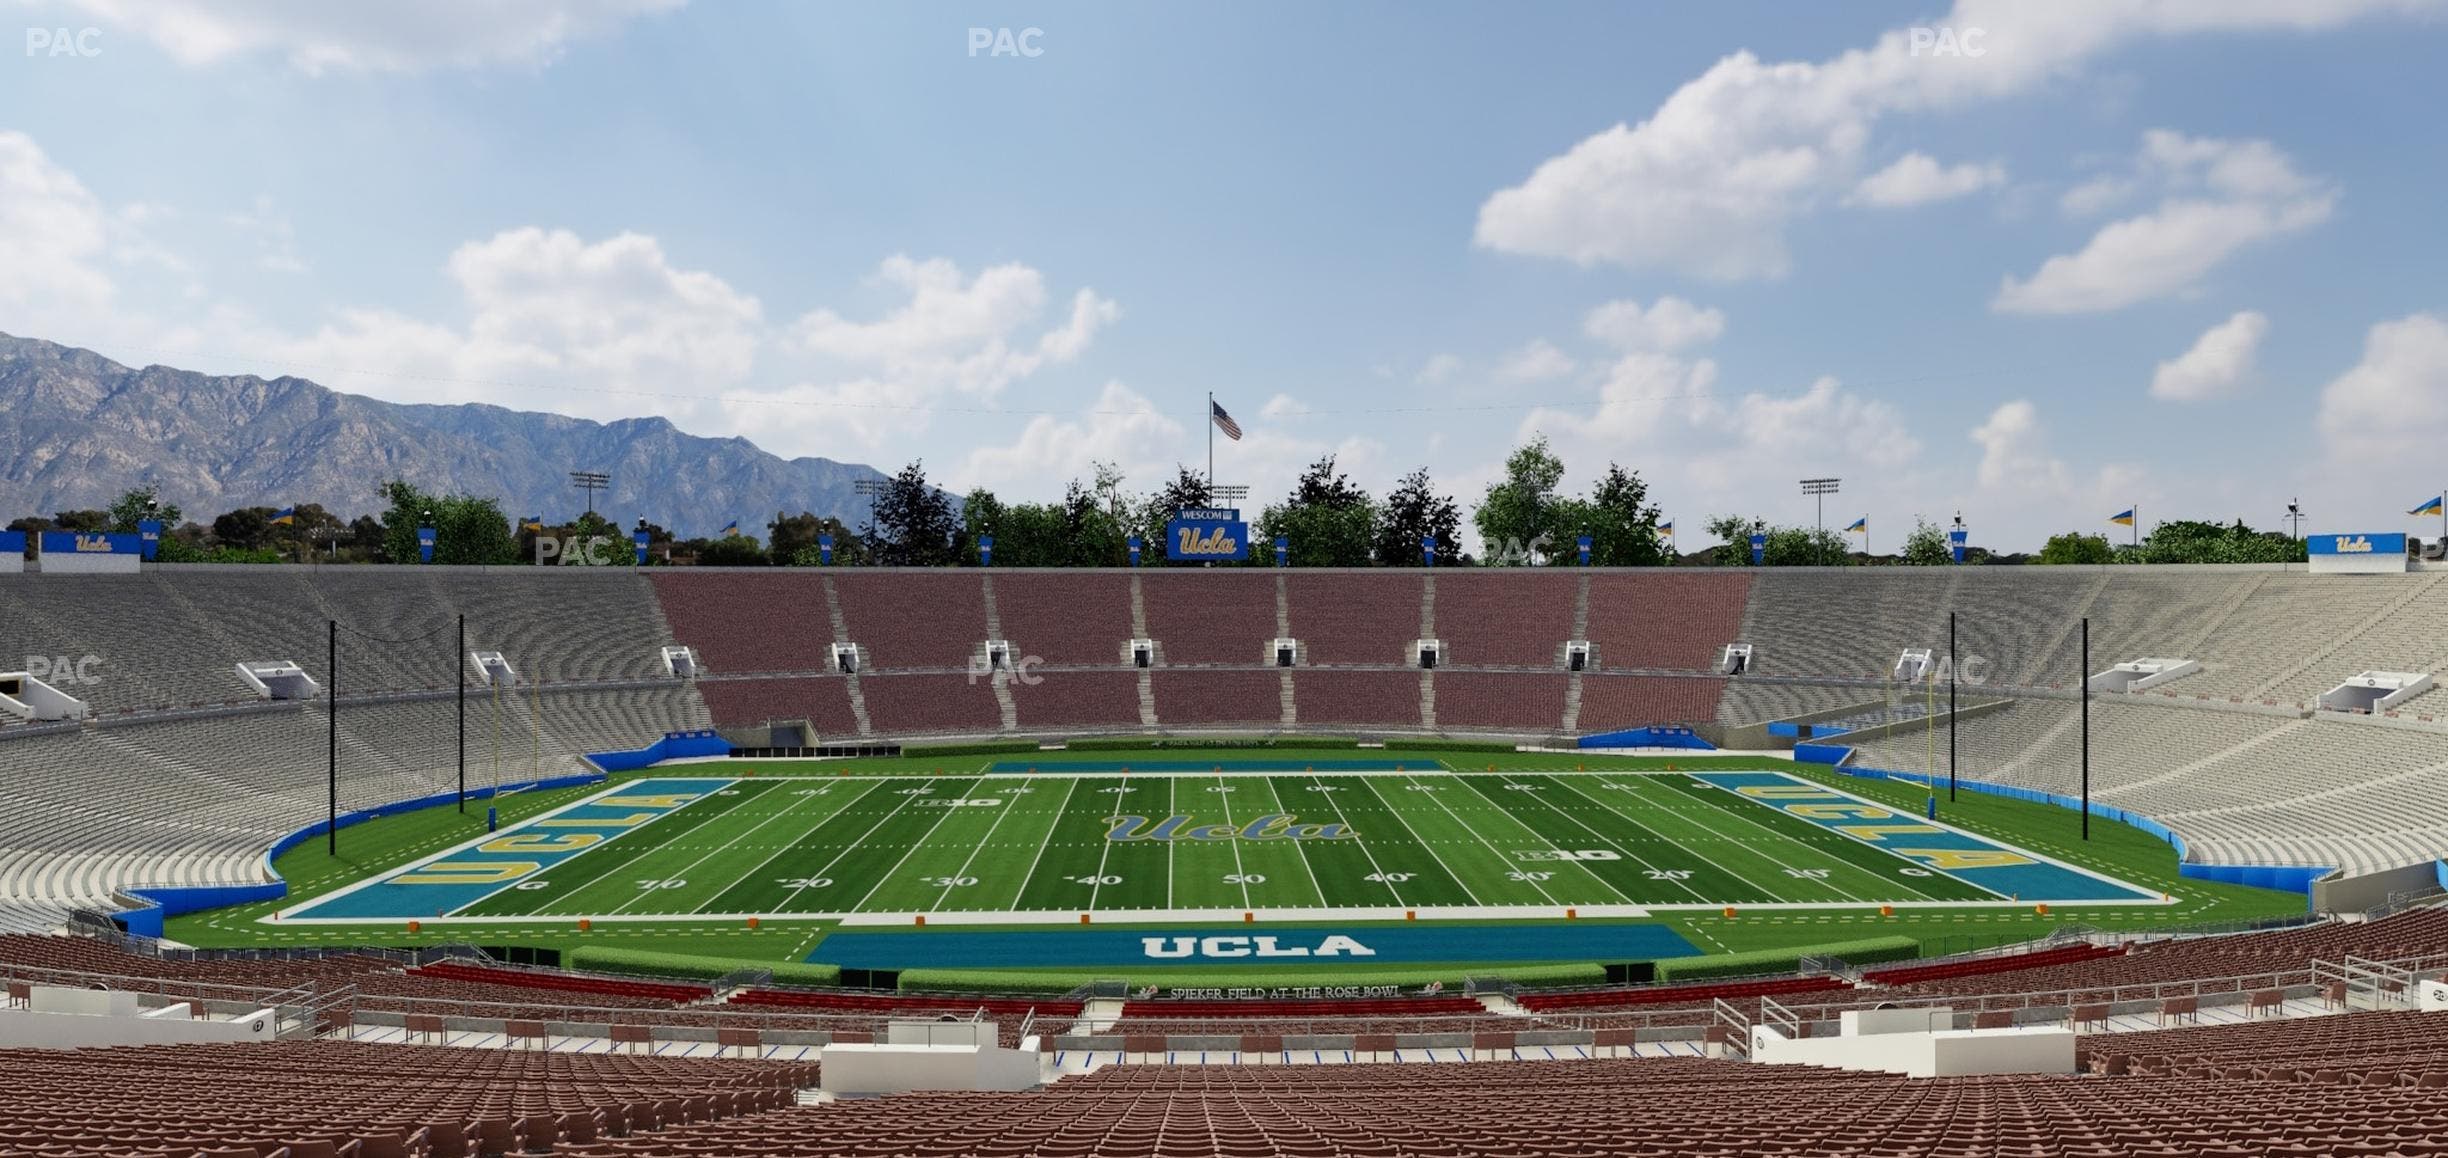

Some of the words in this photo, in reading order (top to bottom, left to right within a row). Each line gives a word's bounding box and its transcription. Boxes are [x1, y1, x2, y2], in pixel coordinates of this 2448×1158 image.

[1182, 511, 1221, 519] WESCOM
[1734, 786, 2040, 869] UCLA
[384, 794, 701, 884] UCLA
[1076, 875, 1123, 885] 40
[1222, 874, 1266, 884] 50
[1363, 872, 1409, 882] 40
[1504, 871, 1550, 881] 30
[1642, 870, 1691, 880] 20
[636, 879, 687, 890] 10
[781, 878, 834, 888] 20
[932, 876, 979, 886] 30
[1142, 935, 1376, 957] UCLA
[1170, 988, 1223, 999] SPIEKER
[1228, 988, 1266, 999] FIELD
[1270, 988, 1288, 999] AT
[1293, 987, 1320, 999] THE
[1325, 986, 1359, 998] ROSE
[1363, 985, 1402, 998] BOWL
